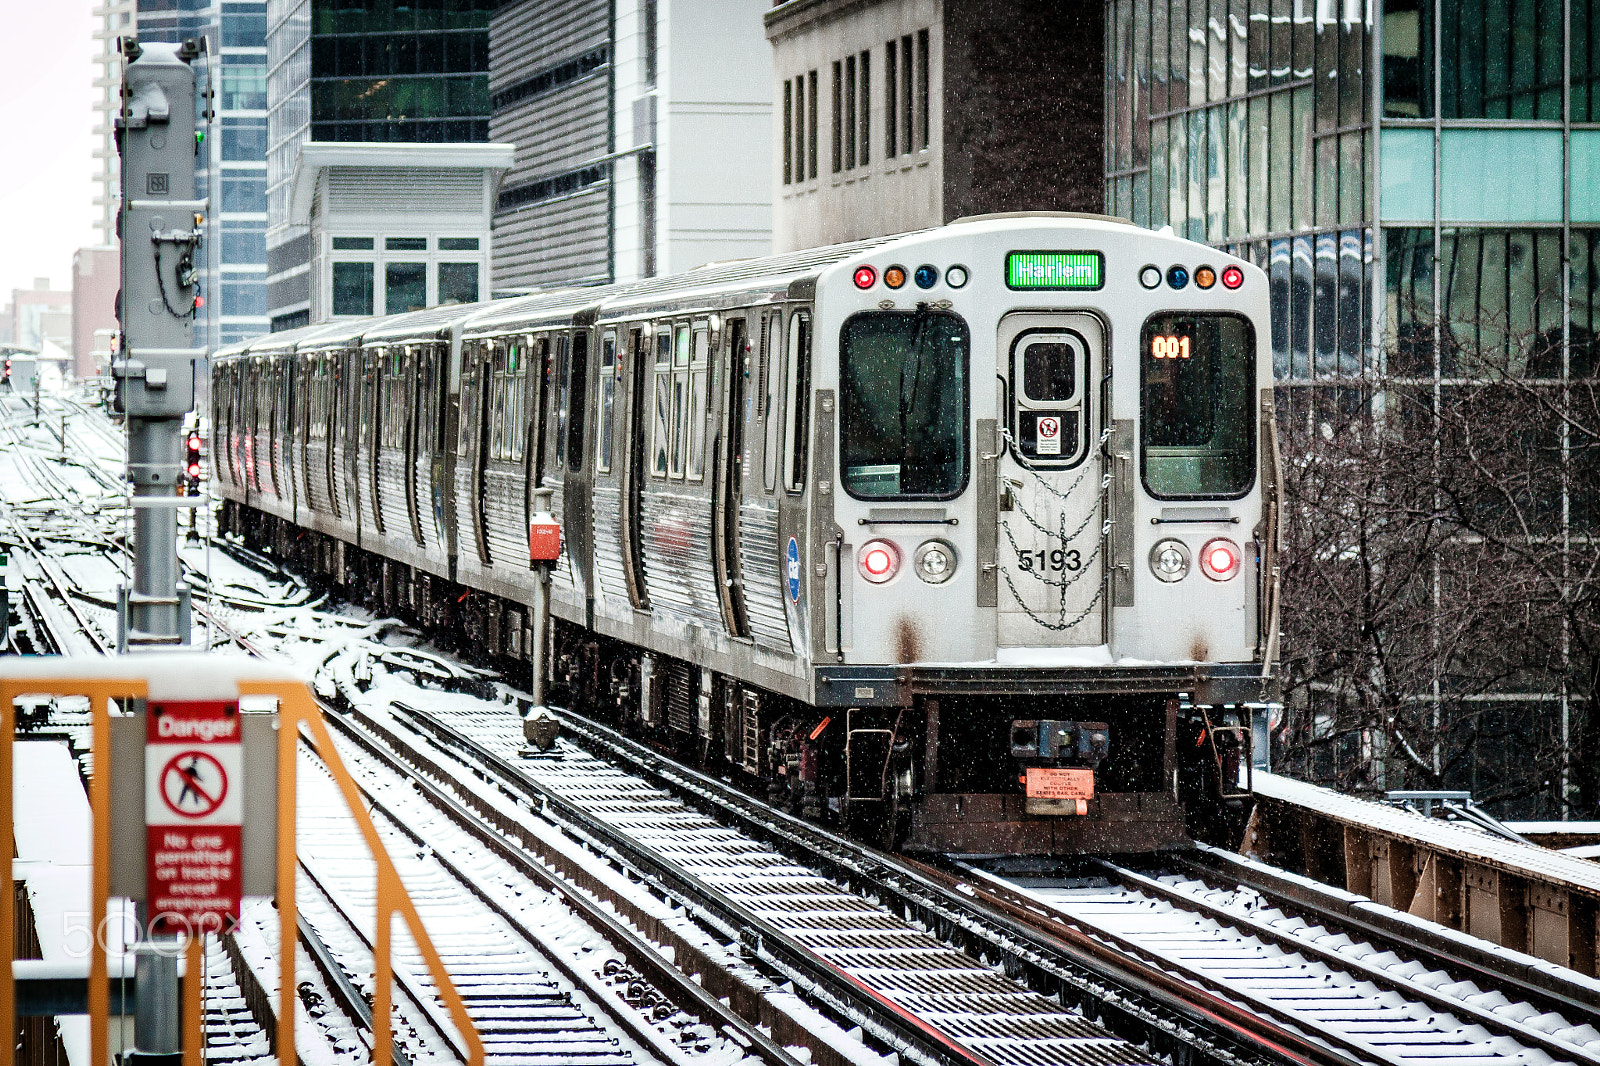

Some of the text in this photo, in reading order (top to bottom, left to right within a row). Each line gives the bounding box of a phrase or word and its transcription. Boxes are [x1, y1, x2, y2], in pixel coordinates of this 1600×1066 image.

[1018, 261, 1091, 278] Harlem
[1152, 335, 1190, 359] 001
[1018, 549, 1082, 571] 5193
[157, 715, 236, 741] Danger
[164, 832, 223, 850] No one
[155, 849, 233, 868] permitted
[156, 866, 231, 880] on tracks
[169, 882, 217, 896] except
[155, 898, 232, 911] employees
